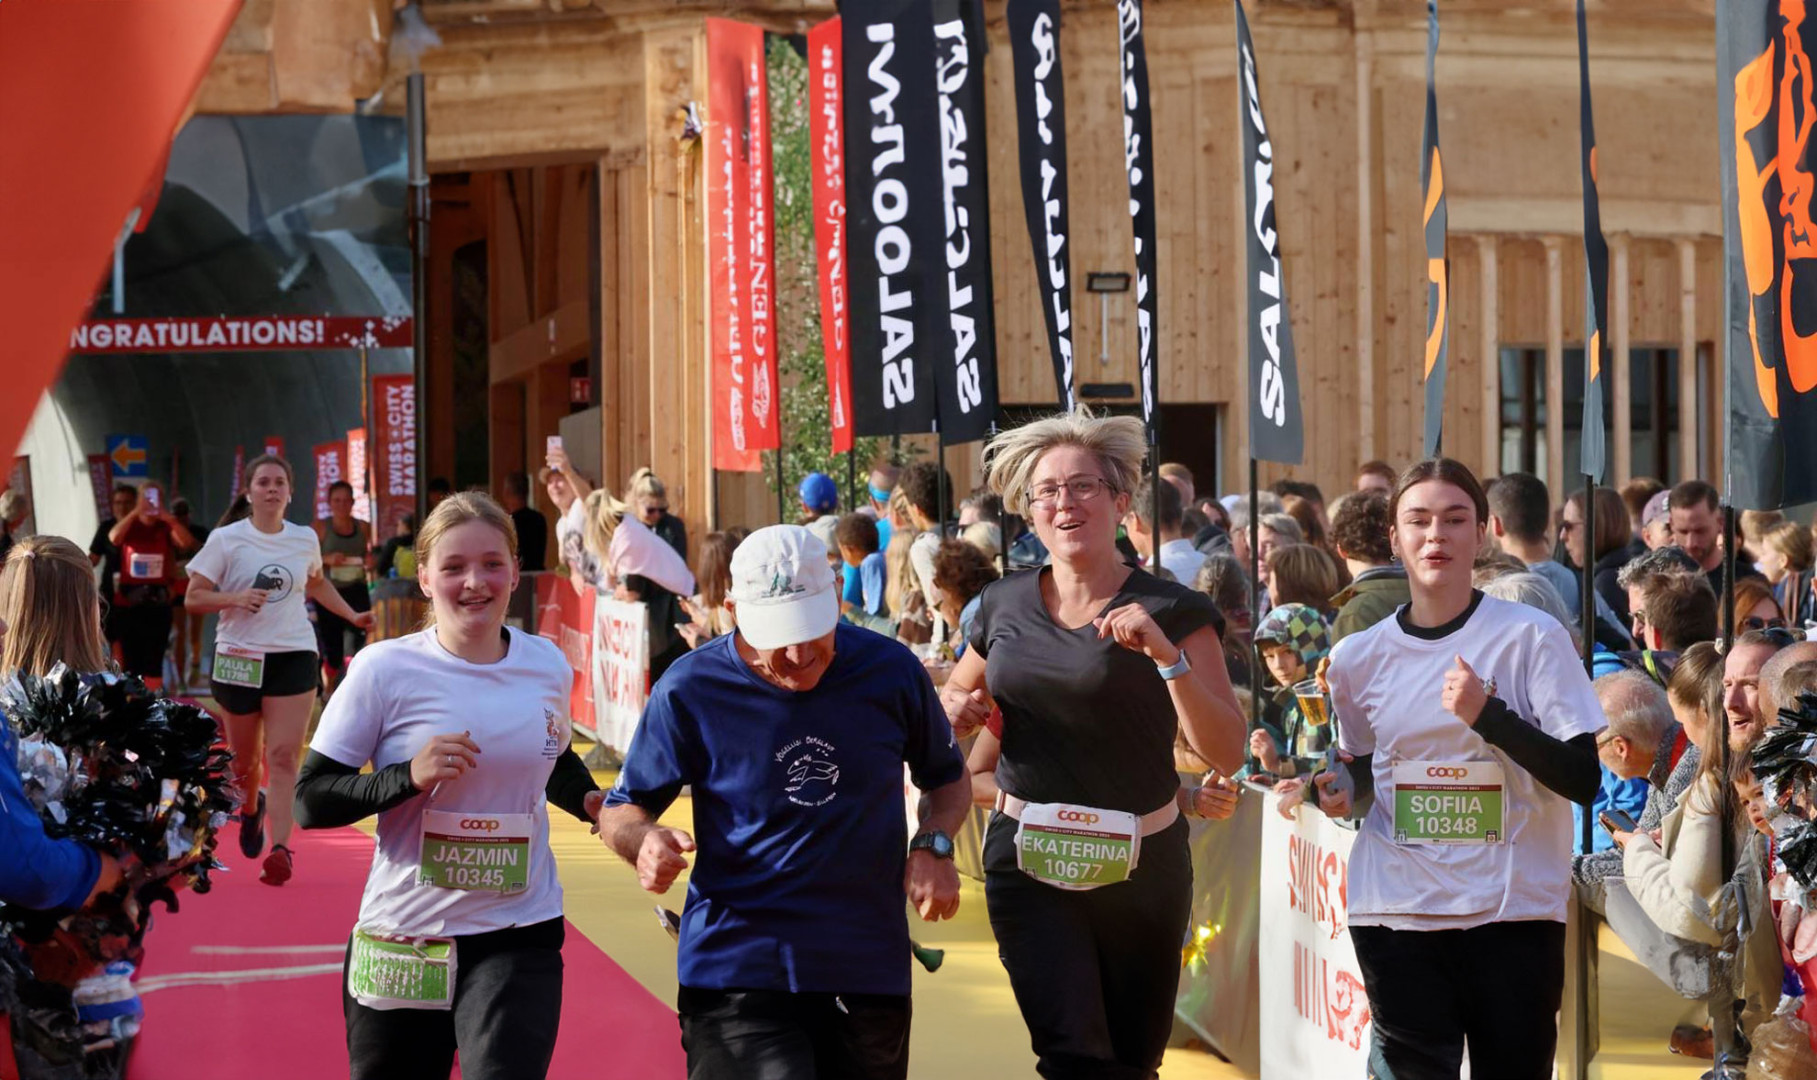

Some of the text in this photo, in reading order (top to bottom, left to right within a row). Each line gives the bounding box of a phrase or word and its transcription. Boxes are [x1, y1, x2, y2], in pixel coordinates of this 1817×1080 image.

[386, 385, 404, 497] SWISS CITY
[401, 384, 416, 497] MARATHON
[218, 658, 253, 672] PAULA
[1426, 767, 1468, 780] coop
[1410, 795, 1483, 814] SOFIIA
[460, 819, 499, 832] coop
[1057, 810, 1100, 825] coop
[1415, 816, 1477, 834] 10348
[432, 845, 518, 867] JAZMIN
[1021, 835, 1128, 862] EKATERINA
[445, 866, 504, 886] 10345
[1044, 859, 1104, 879] 10677
